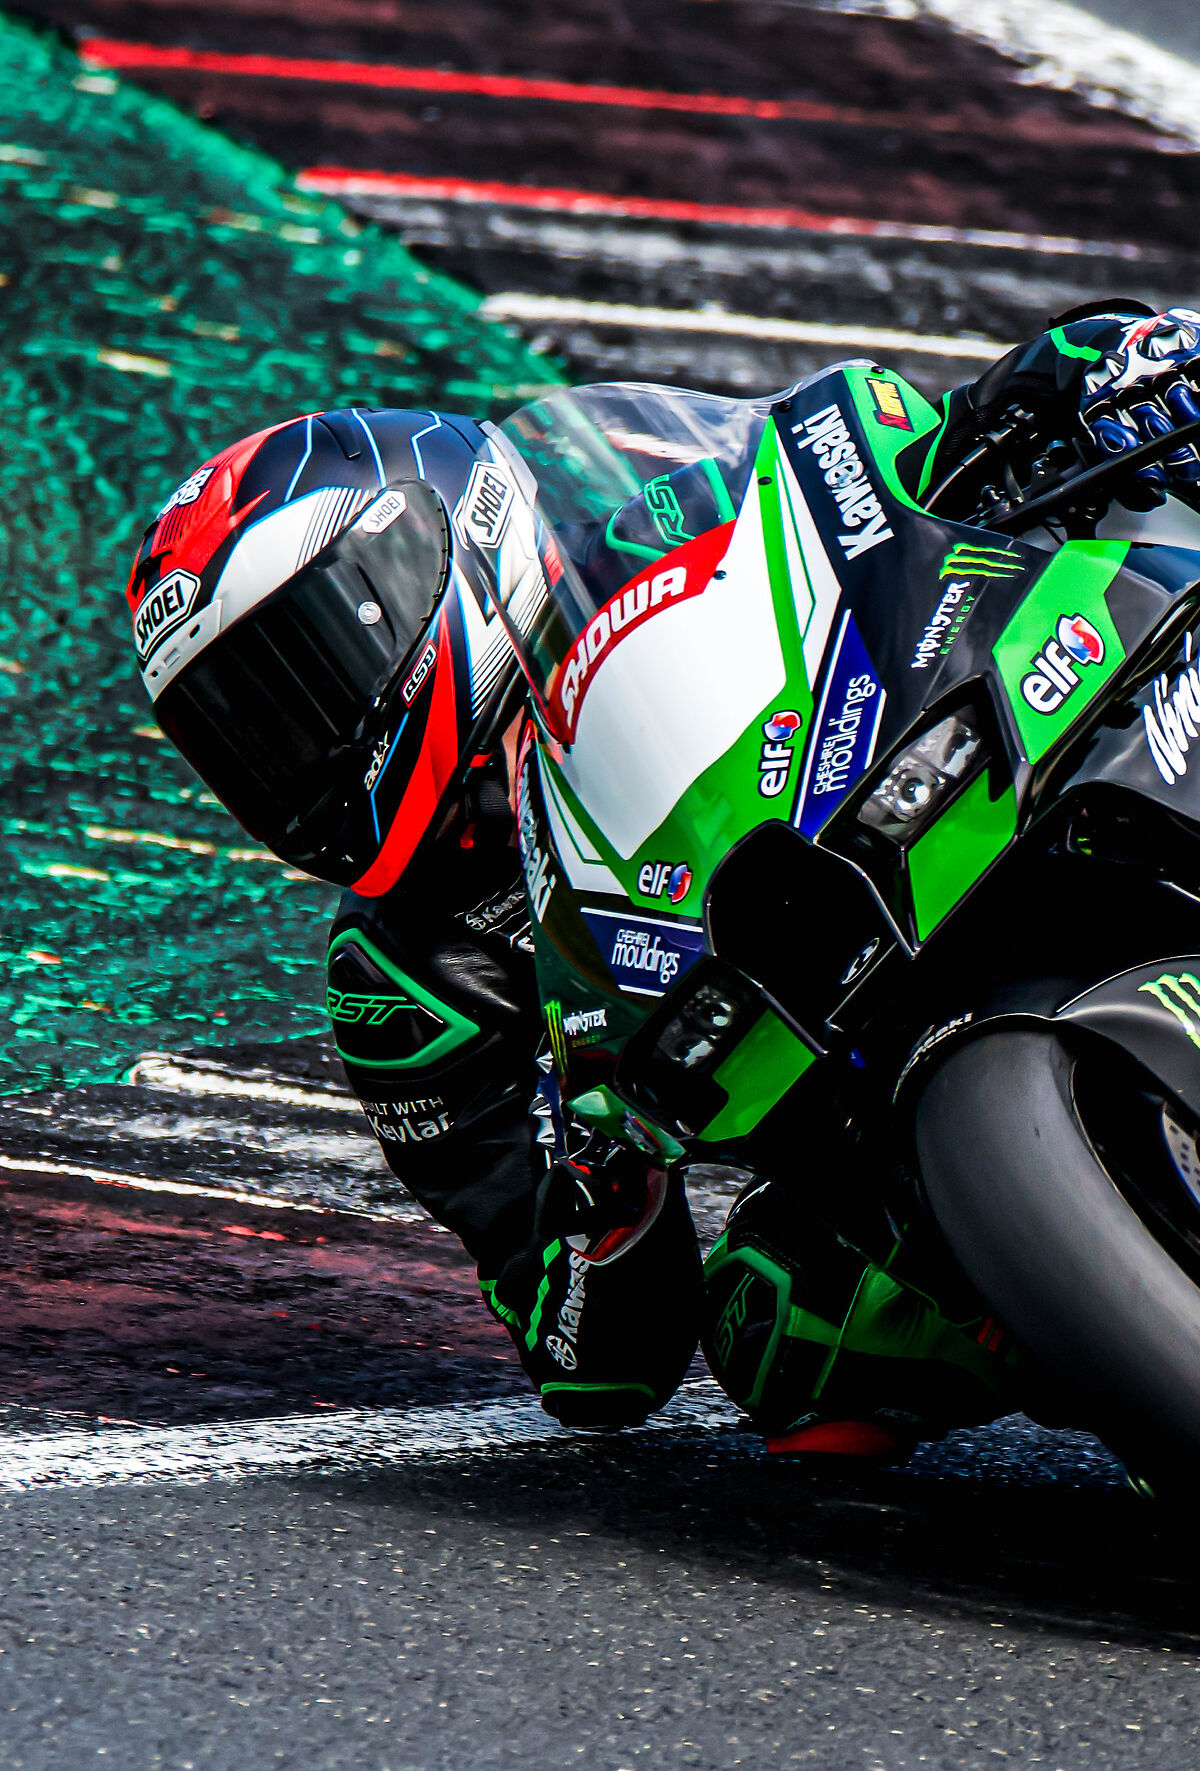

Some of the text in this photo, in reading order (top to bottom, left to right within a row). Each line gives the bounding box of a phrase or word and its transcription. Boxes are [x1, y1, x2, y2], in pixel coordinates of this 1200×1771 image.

[369, 496, 401, 527] SHOEI
[471, 471, 508, 538] SHOEI
[791, 403, 894, 561] Kawasaki
[136, 580, 186, 650] SHOEI
[910, 581, 971, 669] MONSTER
[939, 595, 975, 655] ENERGY
[561, 566, 688, 729] SHOWA
[1023, 641, 1080, 714] elf
[824, 674, 877, 793] mouldings
[760, 743, 793, 796] elf
[813, 737, 836, 795] CHESHIRE
[638, 863, 673, 896] elf
[326, 986, 418, 1025] RST
[367, 1111, 451, 1143] Kevlar
[392, 1096, 444, 1116] WITH
